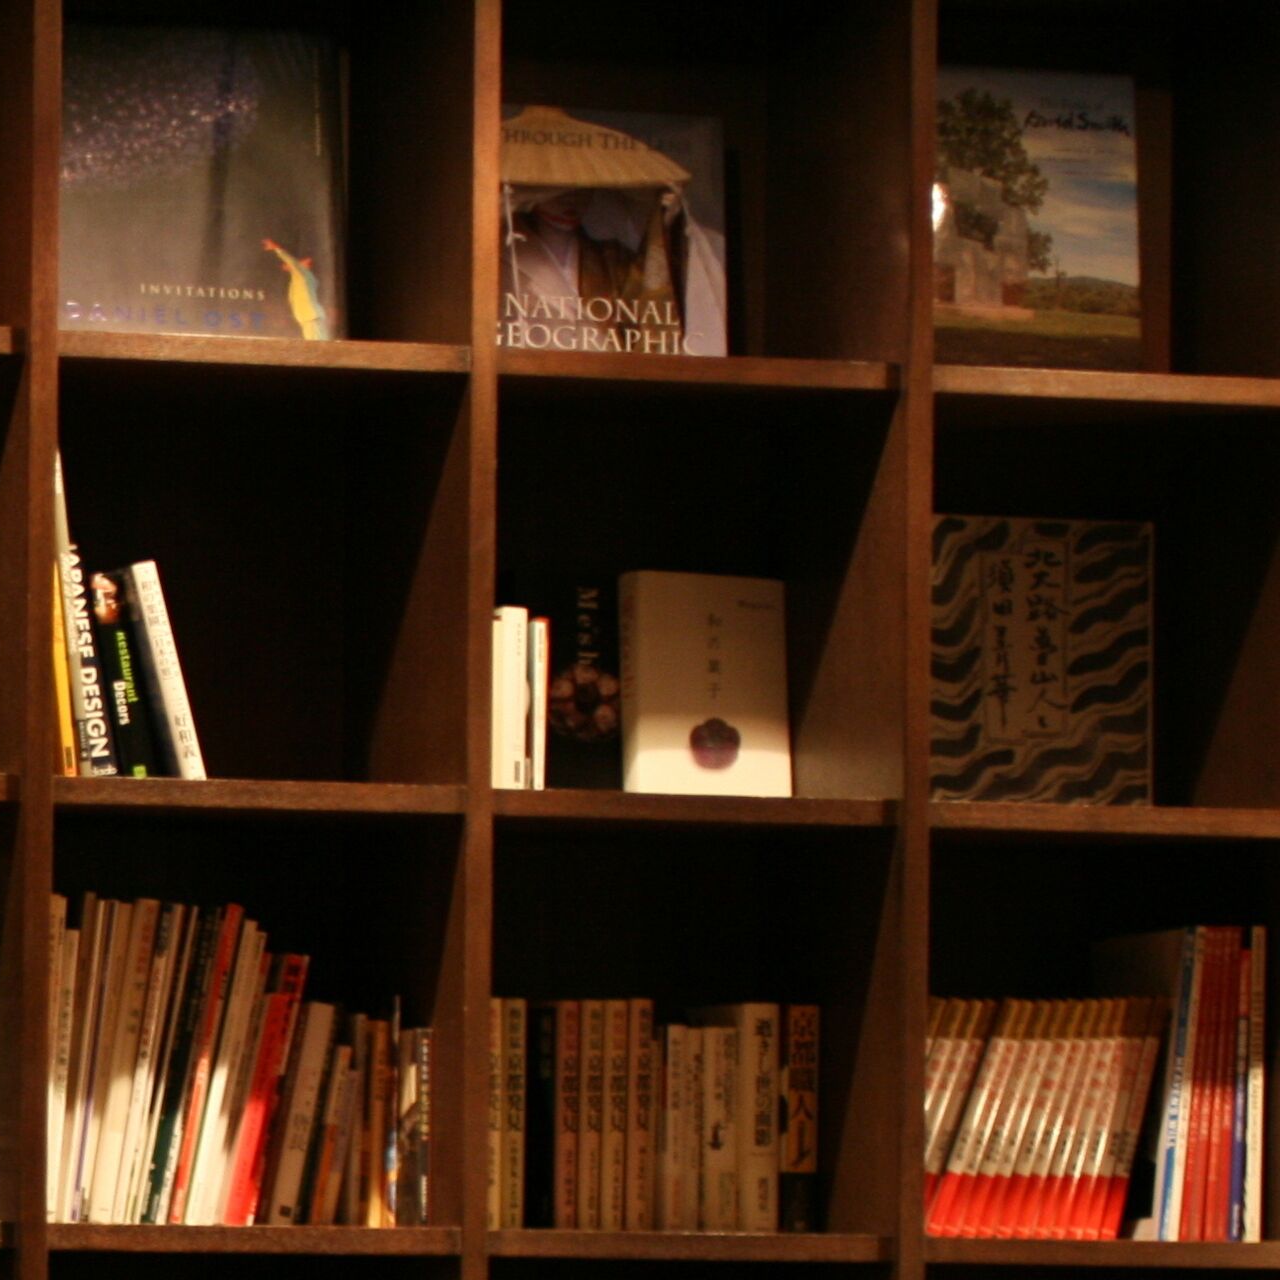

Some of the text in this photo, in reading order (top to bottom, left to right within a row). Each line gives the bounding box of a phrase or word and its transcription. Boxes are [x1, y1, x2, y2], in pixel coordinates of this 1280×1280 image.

[600, 132, 635, 151] THE
[139, 282, 266, 301] INVITATIONS
[64, 300, 267, 329] DANIEL OST
[504, 293, 680, 327] NATIONAL
[66, 544, 111, 758] JAPANESE DESIGN
[116, 631, 139, 704] Restaurant
[113, 680, 130, 726] Decors
